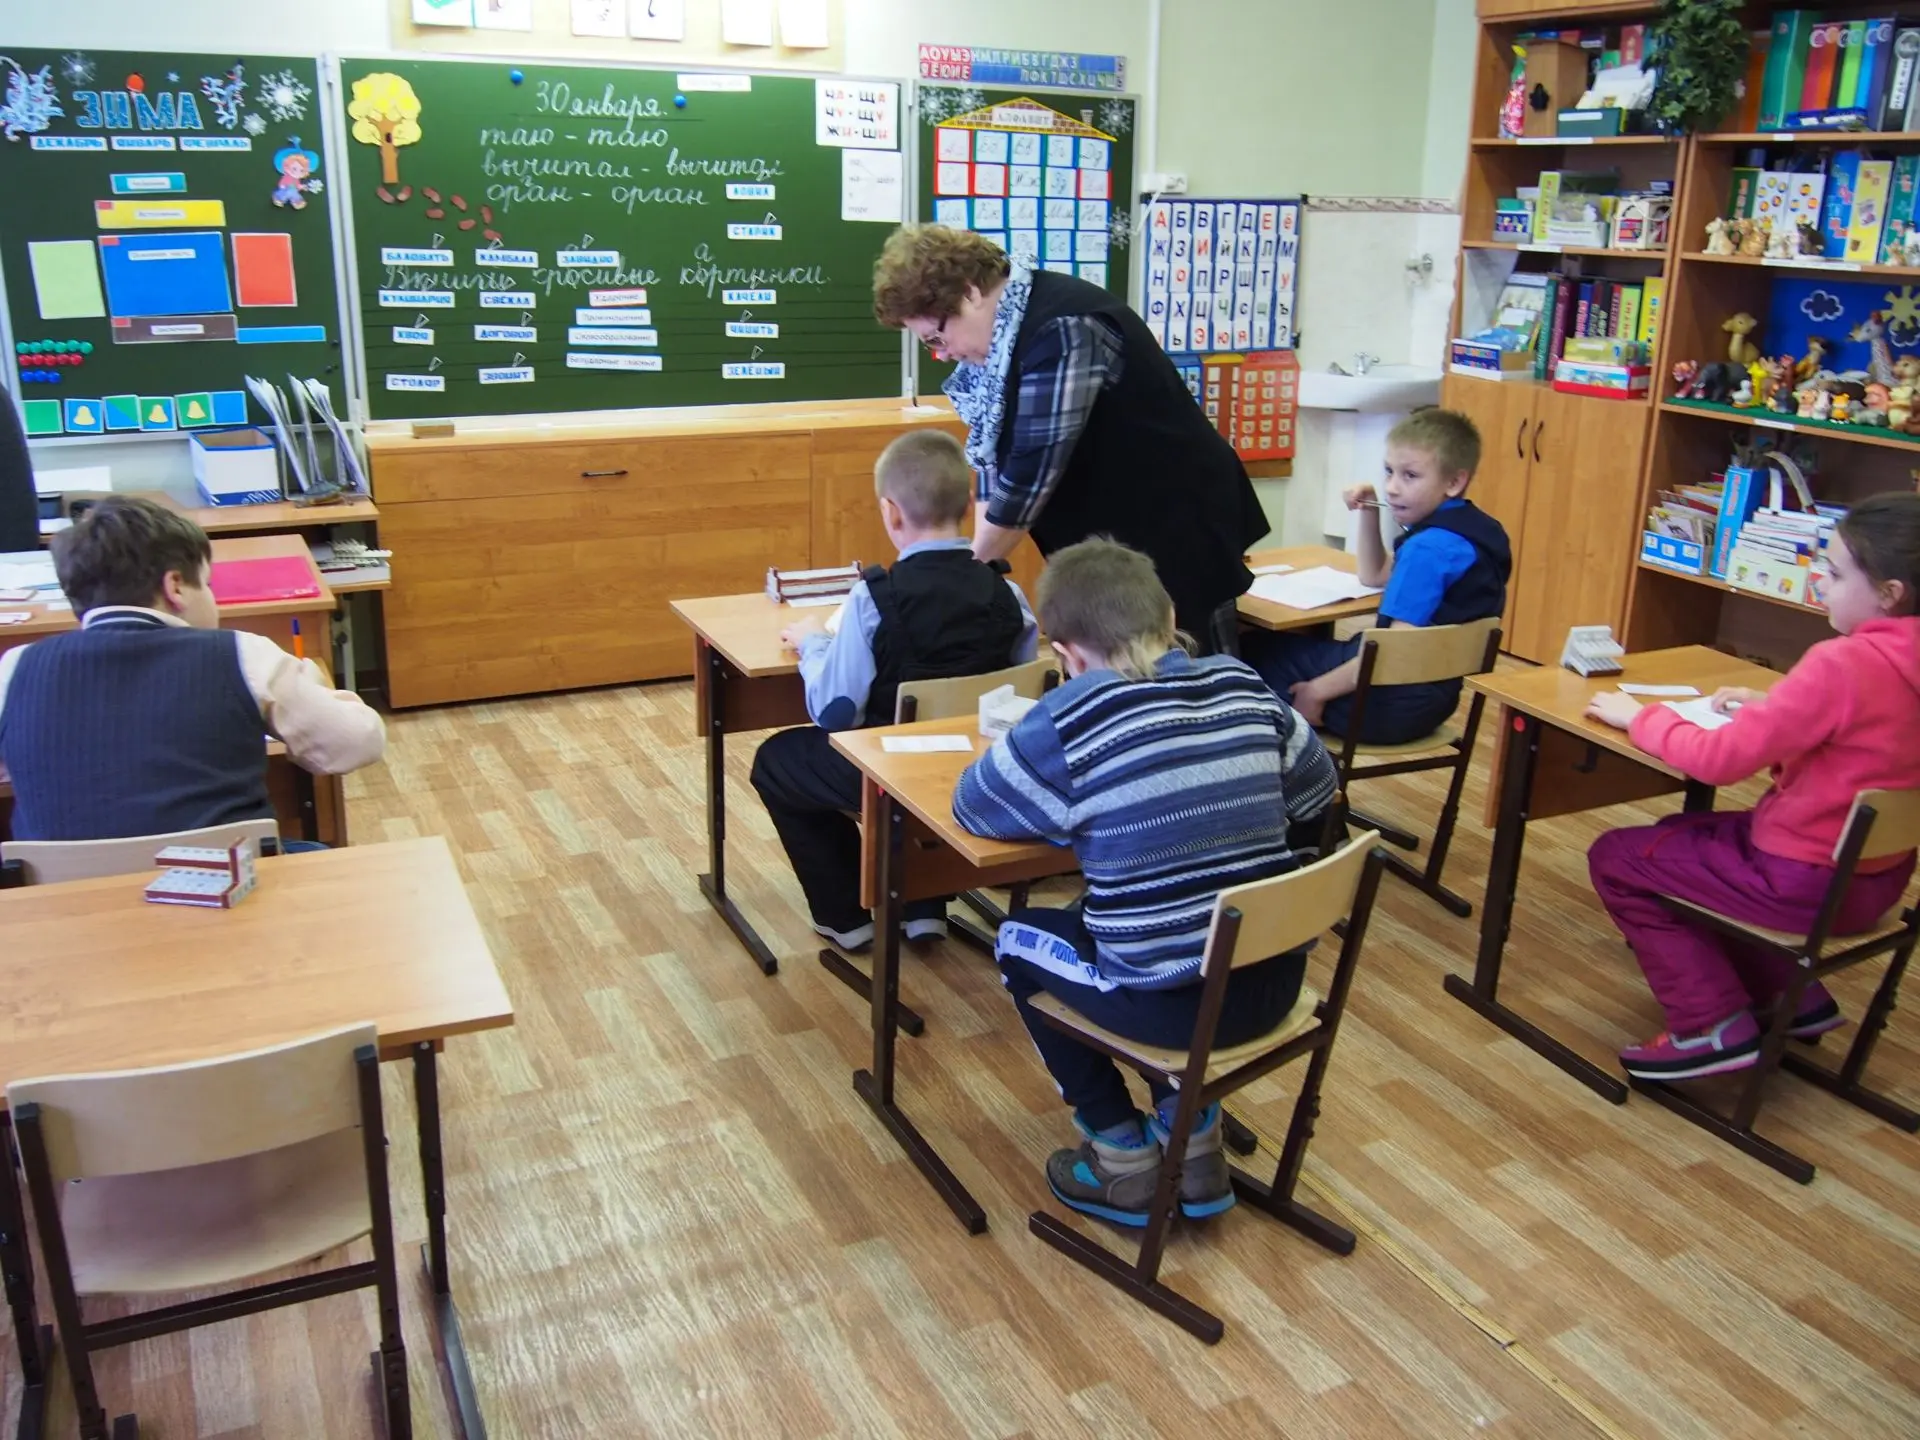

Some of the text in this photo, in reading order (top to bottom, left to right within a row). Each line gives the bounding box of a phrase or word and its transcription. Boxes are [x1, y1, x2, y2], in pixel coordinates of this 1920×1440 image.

[72, 90, 205, 131] ЗИМА
[1155, 210, 1167, 227] А
[1177, 211, 1186, 228] Б
[1198, 211, 1208, 228] В
[1221, 212, 1231, 228] Г
[1240, 213, 1252, 232] Д
